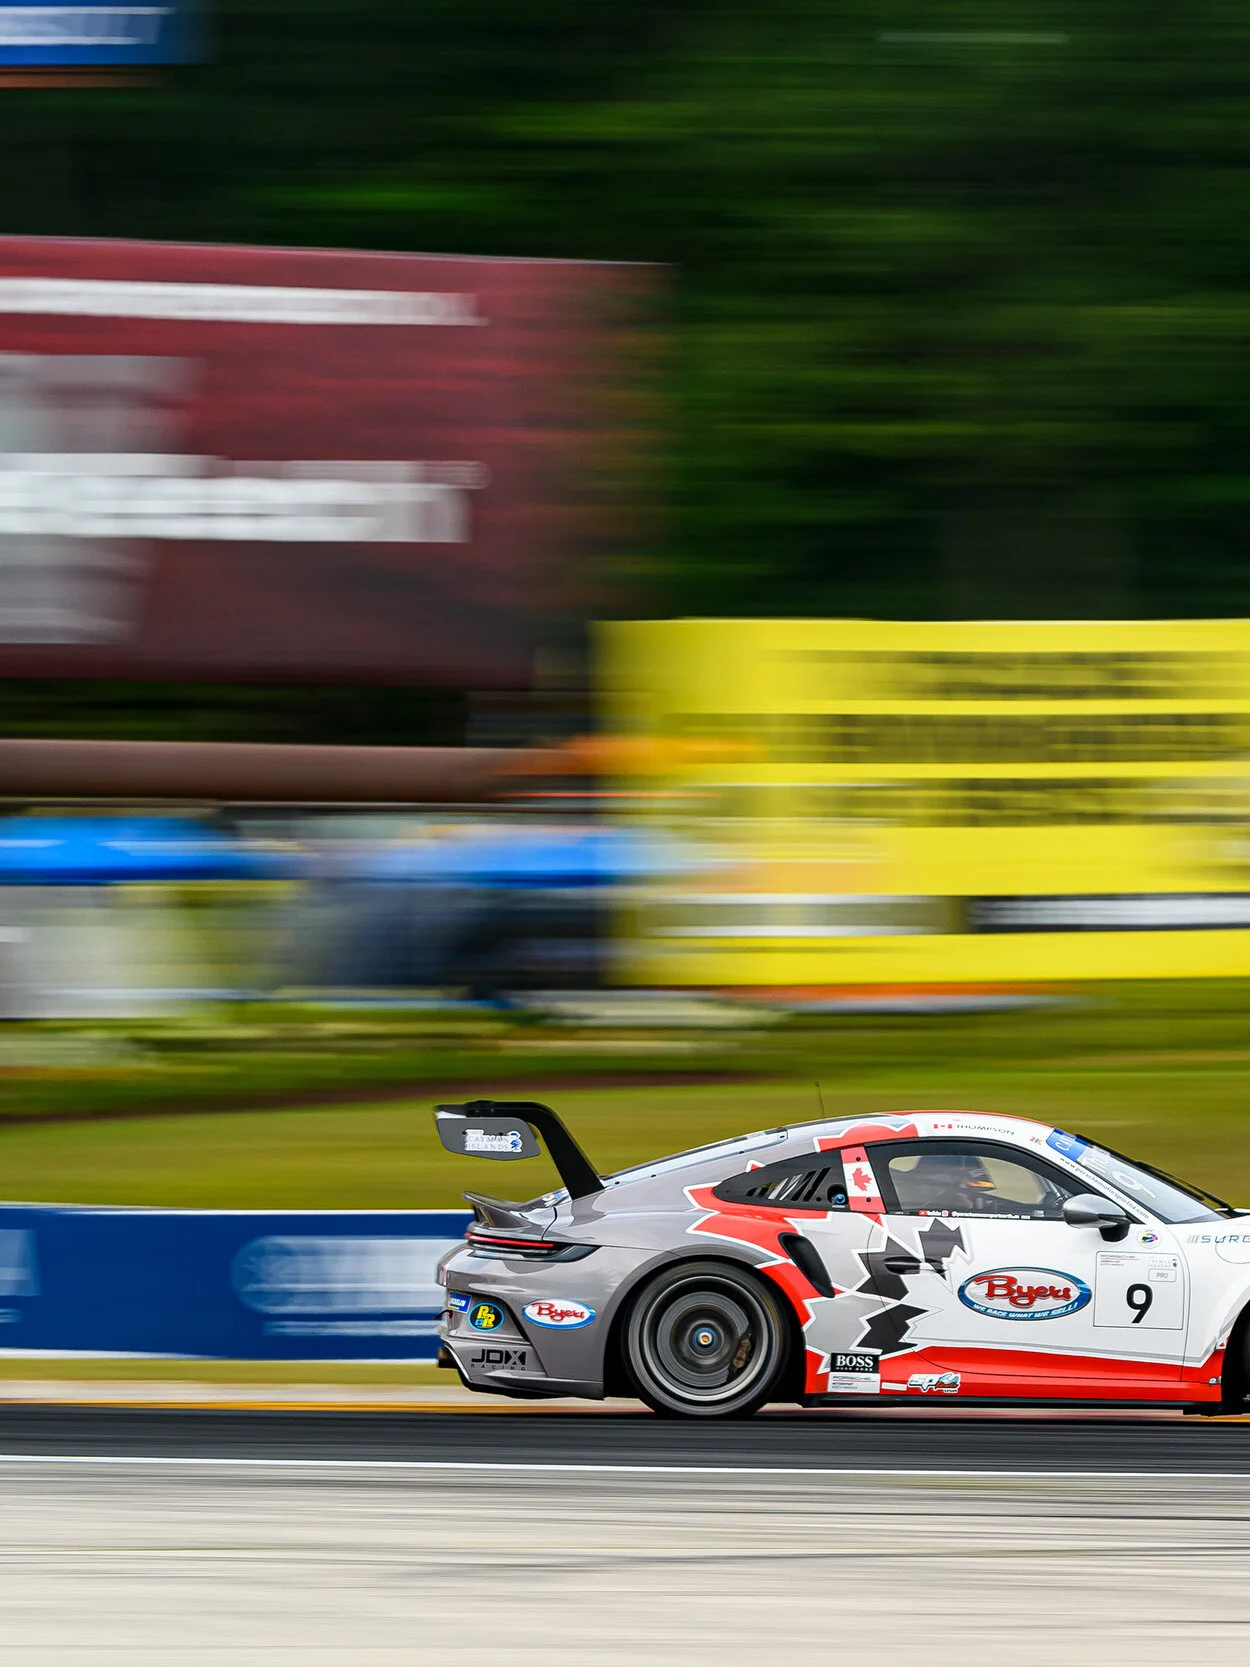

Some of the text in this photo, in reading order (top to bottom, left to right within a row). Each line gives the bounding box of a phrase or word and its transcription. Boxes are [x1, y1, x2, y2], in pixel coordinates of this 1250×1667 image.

[957, 1124, 1015, 1135] THOMPSON
[974, 1275, 1071, 1308] Byers
[973, 1303, 986, 1311] WE
[987, 1308, 1007, 1317] RACE
[1034, 1310, 1050, 1318] WE
[1050, 1302, 1078, 1316] SELL!
[1126, 1283, 1153, 1324] 9
[471, 1349, 527, 1366] JDX
[836, 1355, 874, 1367] BOSS
